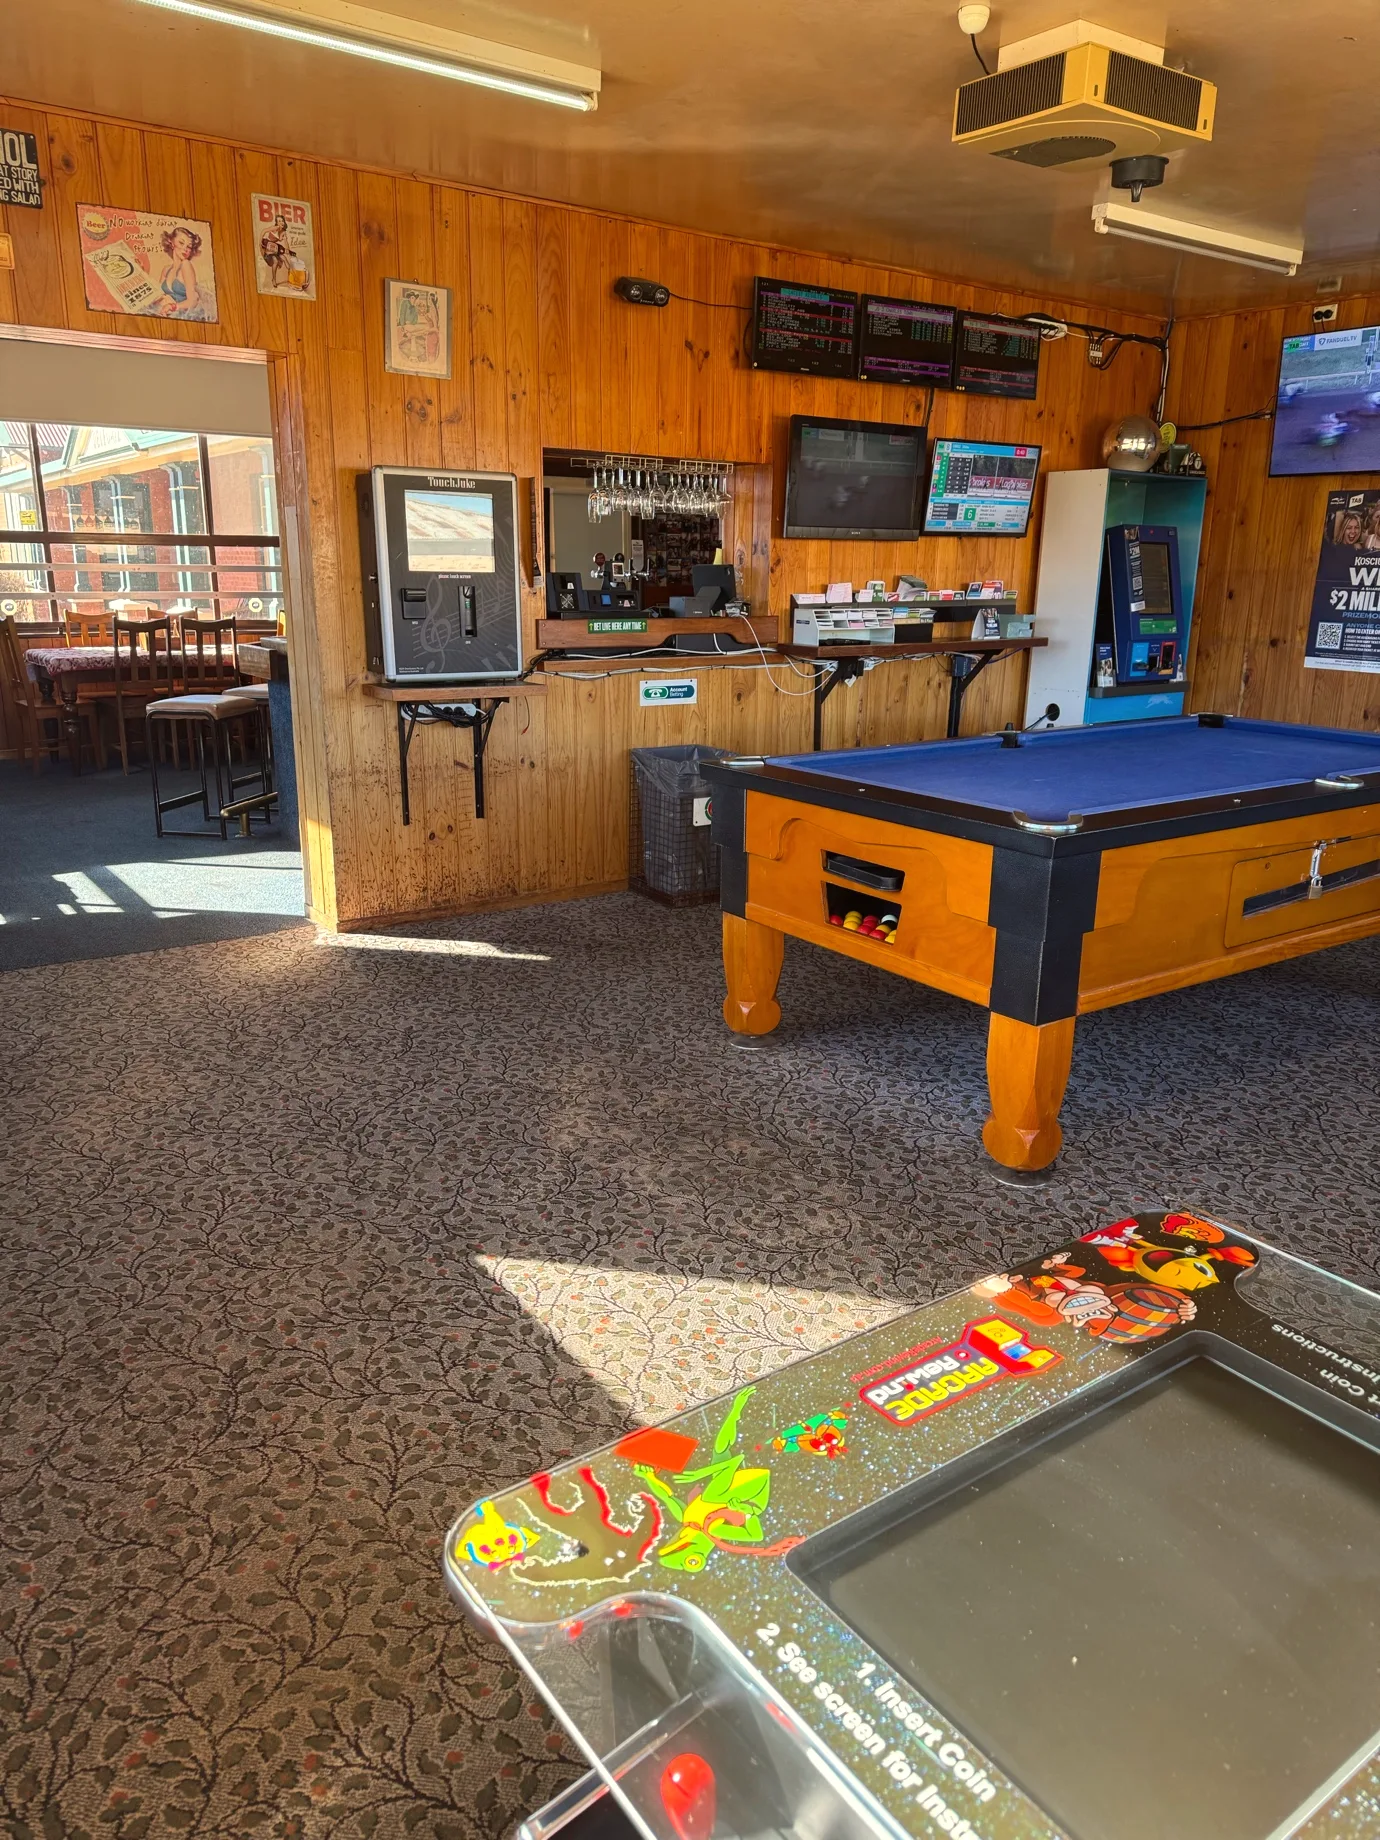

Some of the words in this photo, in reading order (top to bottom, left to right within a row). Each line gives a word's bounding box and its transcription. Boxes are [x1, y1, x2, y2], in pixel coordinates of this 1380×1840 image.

[11, 167, 38, 181] STORY
[13, 179, 39, 194] WITH
[258, 199, 306, 225] BIER
[86, 220, 106, 229] Beer
[110, 215, 123, 228] NO
[1326, 336, 1350, 344] FANDUEL
[427, 476, 476, 489] TouchJuke
[1330, 589, 1349, 610] $2
[593, 622, 601, 631] BET
[623, 621, 631, 630] ANY
[884, 1356, 1000, 1421] ARCADE
[1320, 1369, 1365, 1397] Coin
[756, 1622, 780, 1647] 2.
[777, 1641, 817, 1684] See
[813, 1680, 886, 1755] screen
[881, 1749, 923, 1788] for
[856, 1661, 876, 1685] 1.
[874, 1680, 943, 1747] Insert
[939, 1742, 996, 1802] Coin
